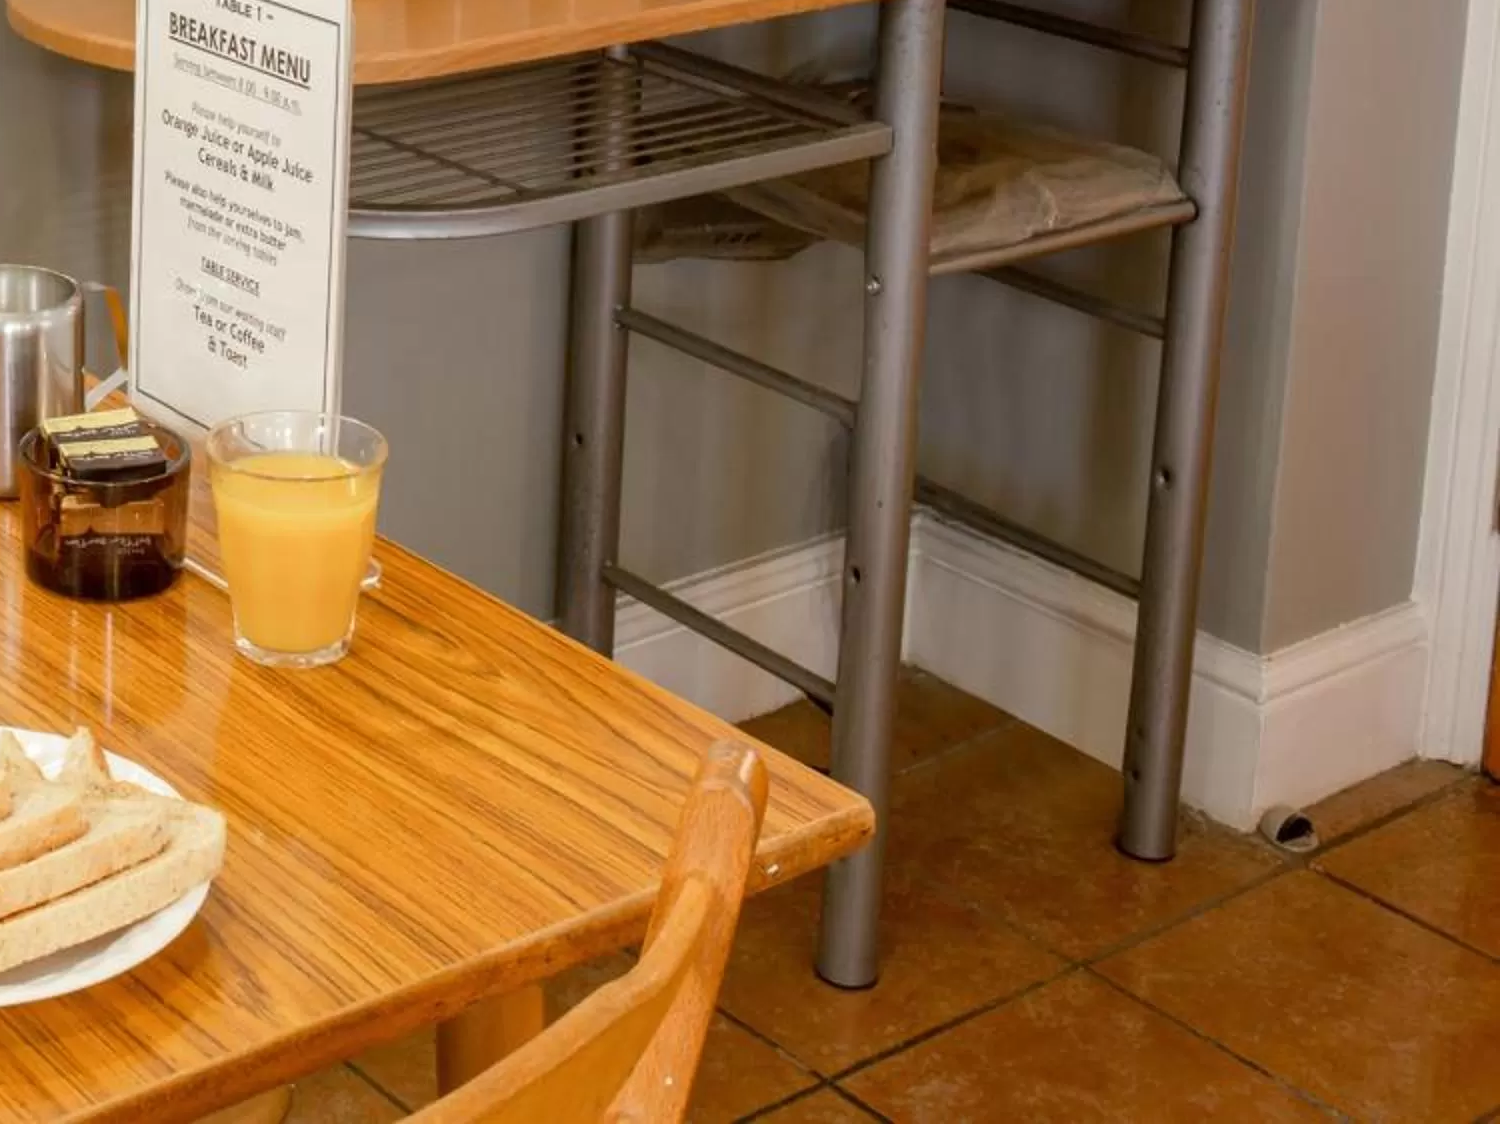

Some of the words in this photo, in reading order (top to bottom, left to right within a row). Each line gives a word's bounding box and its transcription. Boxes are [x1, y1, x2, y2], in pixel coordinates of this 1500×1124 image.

[169, 11, 256, 64] BREAKFAST
[260, 44, 311, 83] MENU
[161, 108, 198, 138] Orange
[201, 126, 230, 149] Juice
[232, 140, 244, 154] or
[248, 144, 279, 168] Apple
[282, 157, 313, 183] Juice
[198, 147, 237, 177] Cereals
[240, 164, 248, 182] &
[251, 170, 273, 190] Milk
[201, 256, 225, 278] TABLE
[226, 266, 260, 295] SERVICE
[192, 303, 213, 327] Tea
[214, 319, 227, 333] or
[230, 323, 265, 355] Coffee
[207, 335, 217, 353] &
[219, 340, 248, 370] Toast
